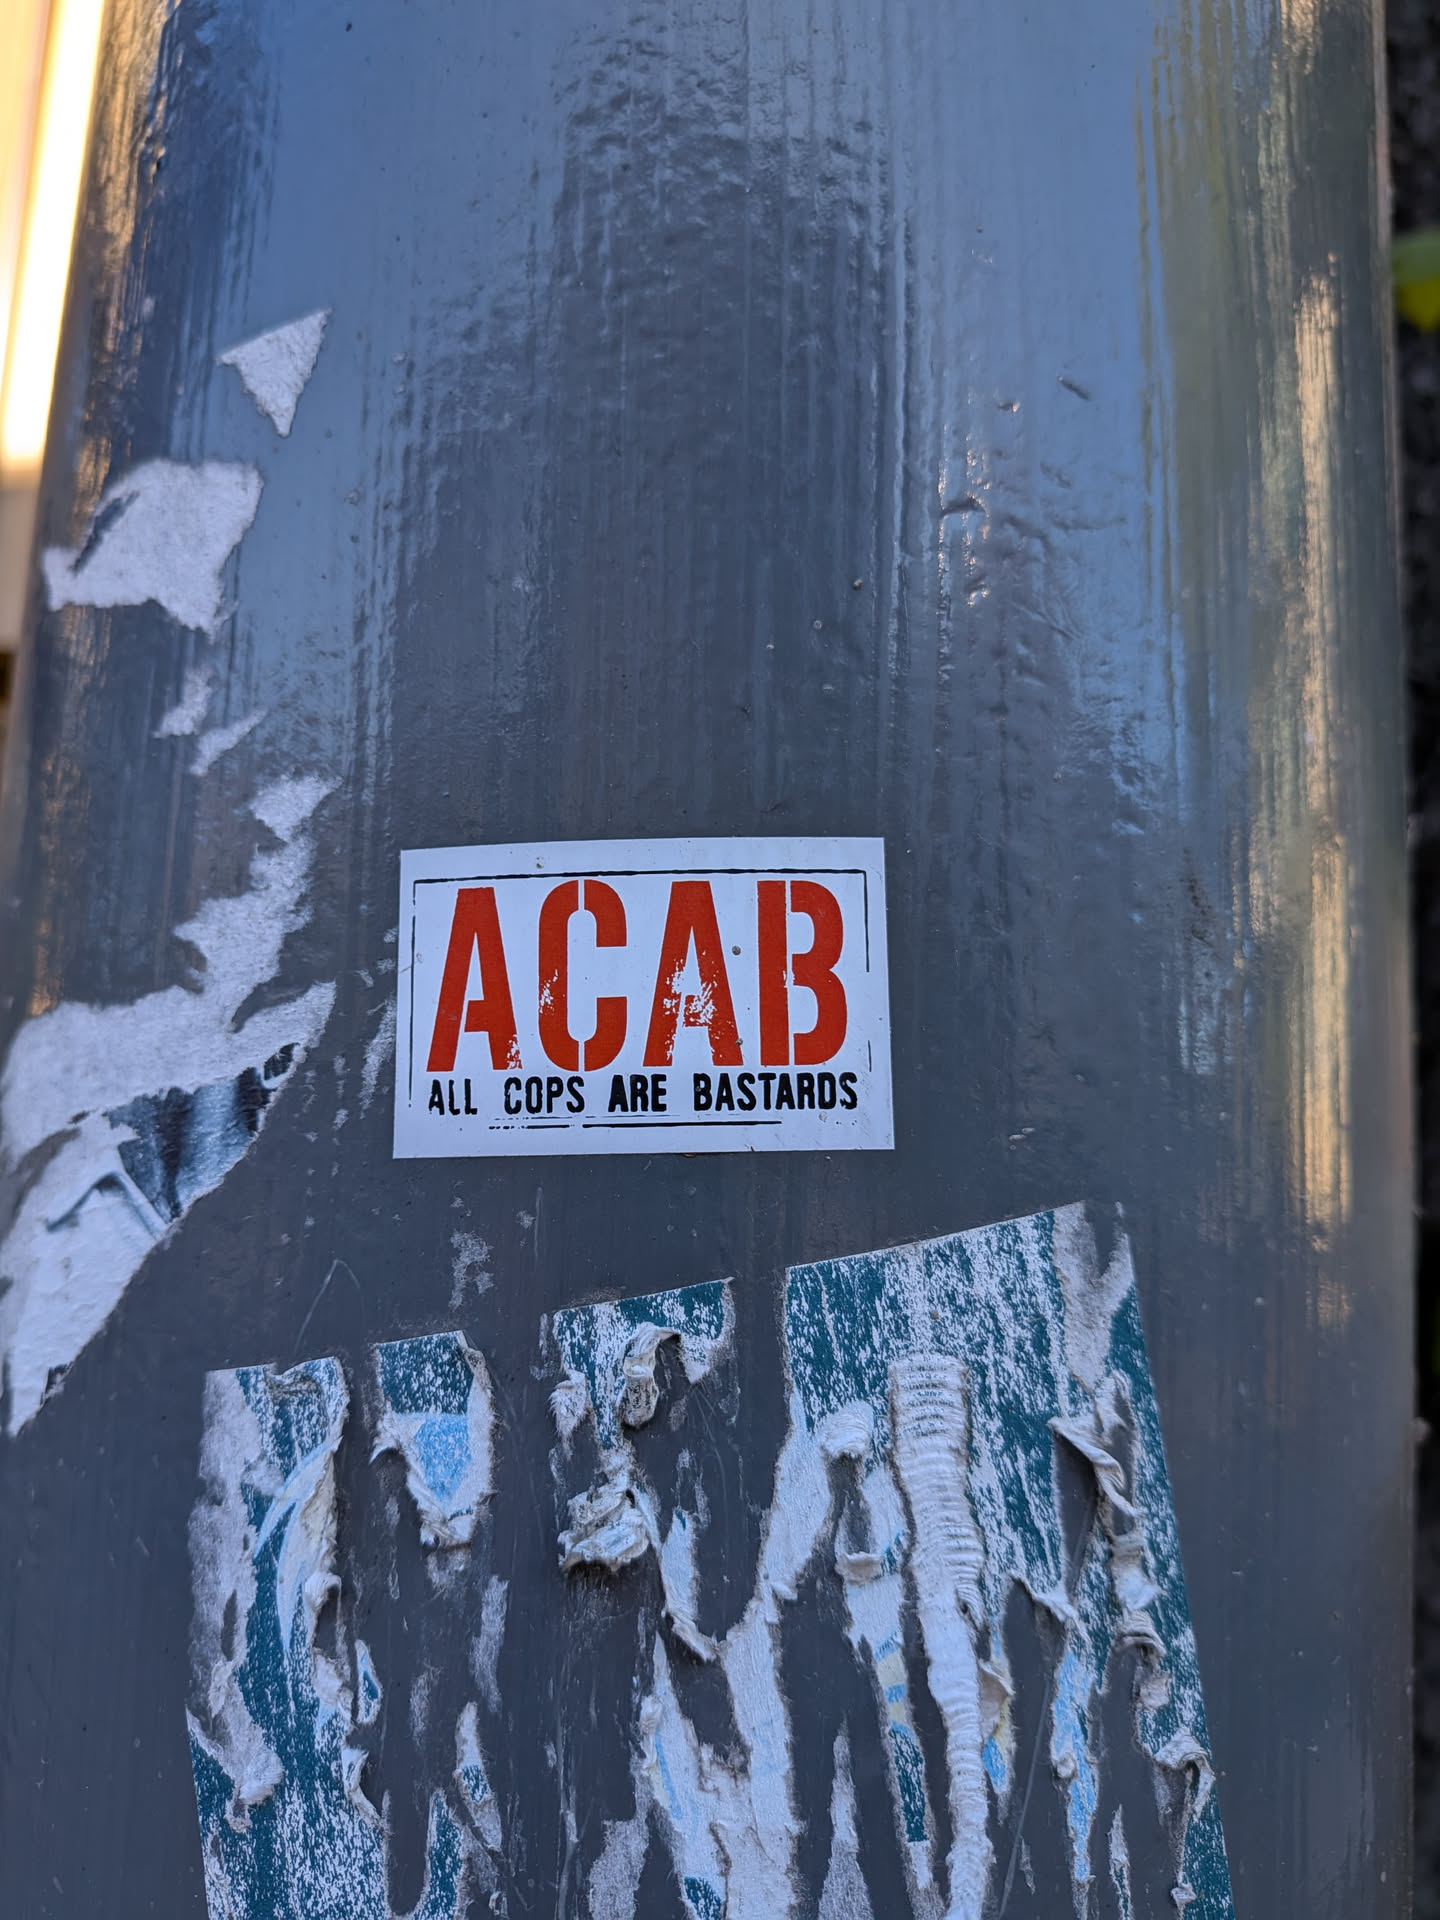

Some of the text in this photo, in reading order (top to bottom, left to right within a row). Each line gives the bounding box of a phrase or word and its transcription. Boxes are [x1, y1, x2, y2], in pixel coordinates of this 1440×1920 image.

[427, 879, 848, 1072] ACAB
[428, 1072, 859, 1116] ALL COPS ARE BASTARDS
